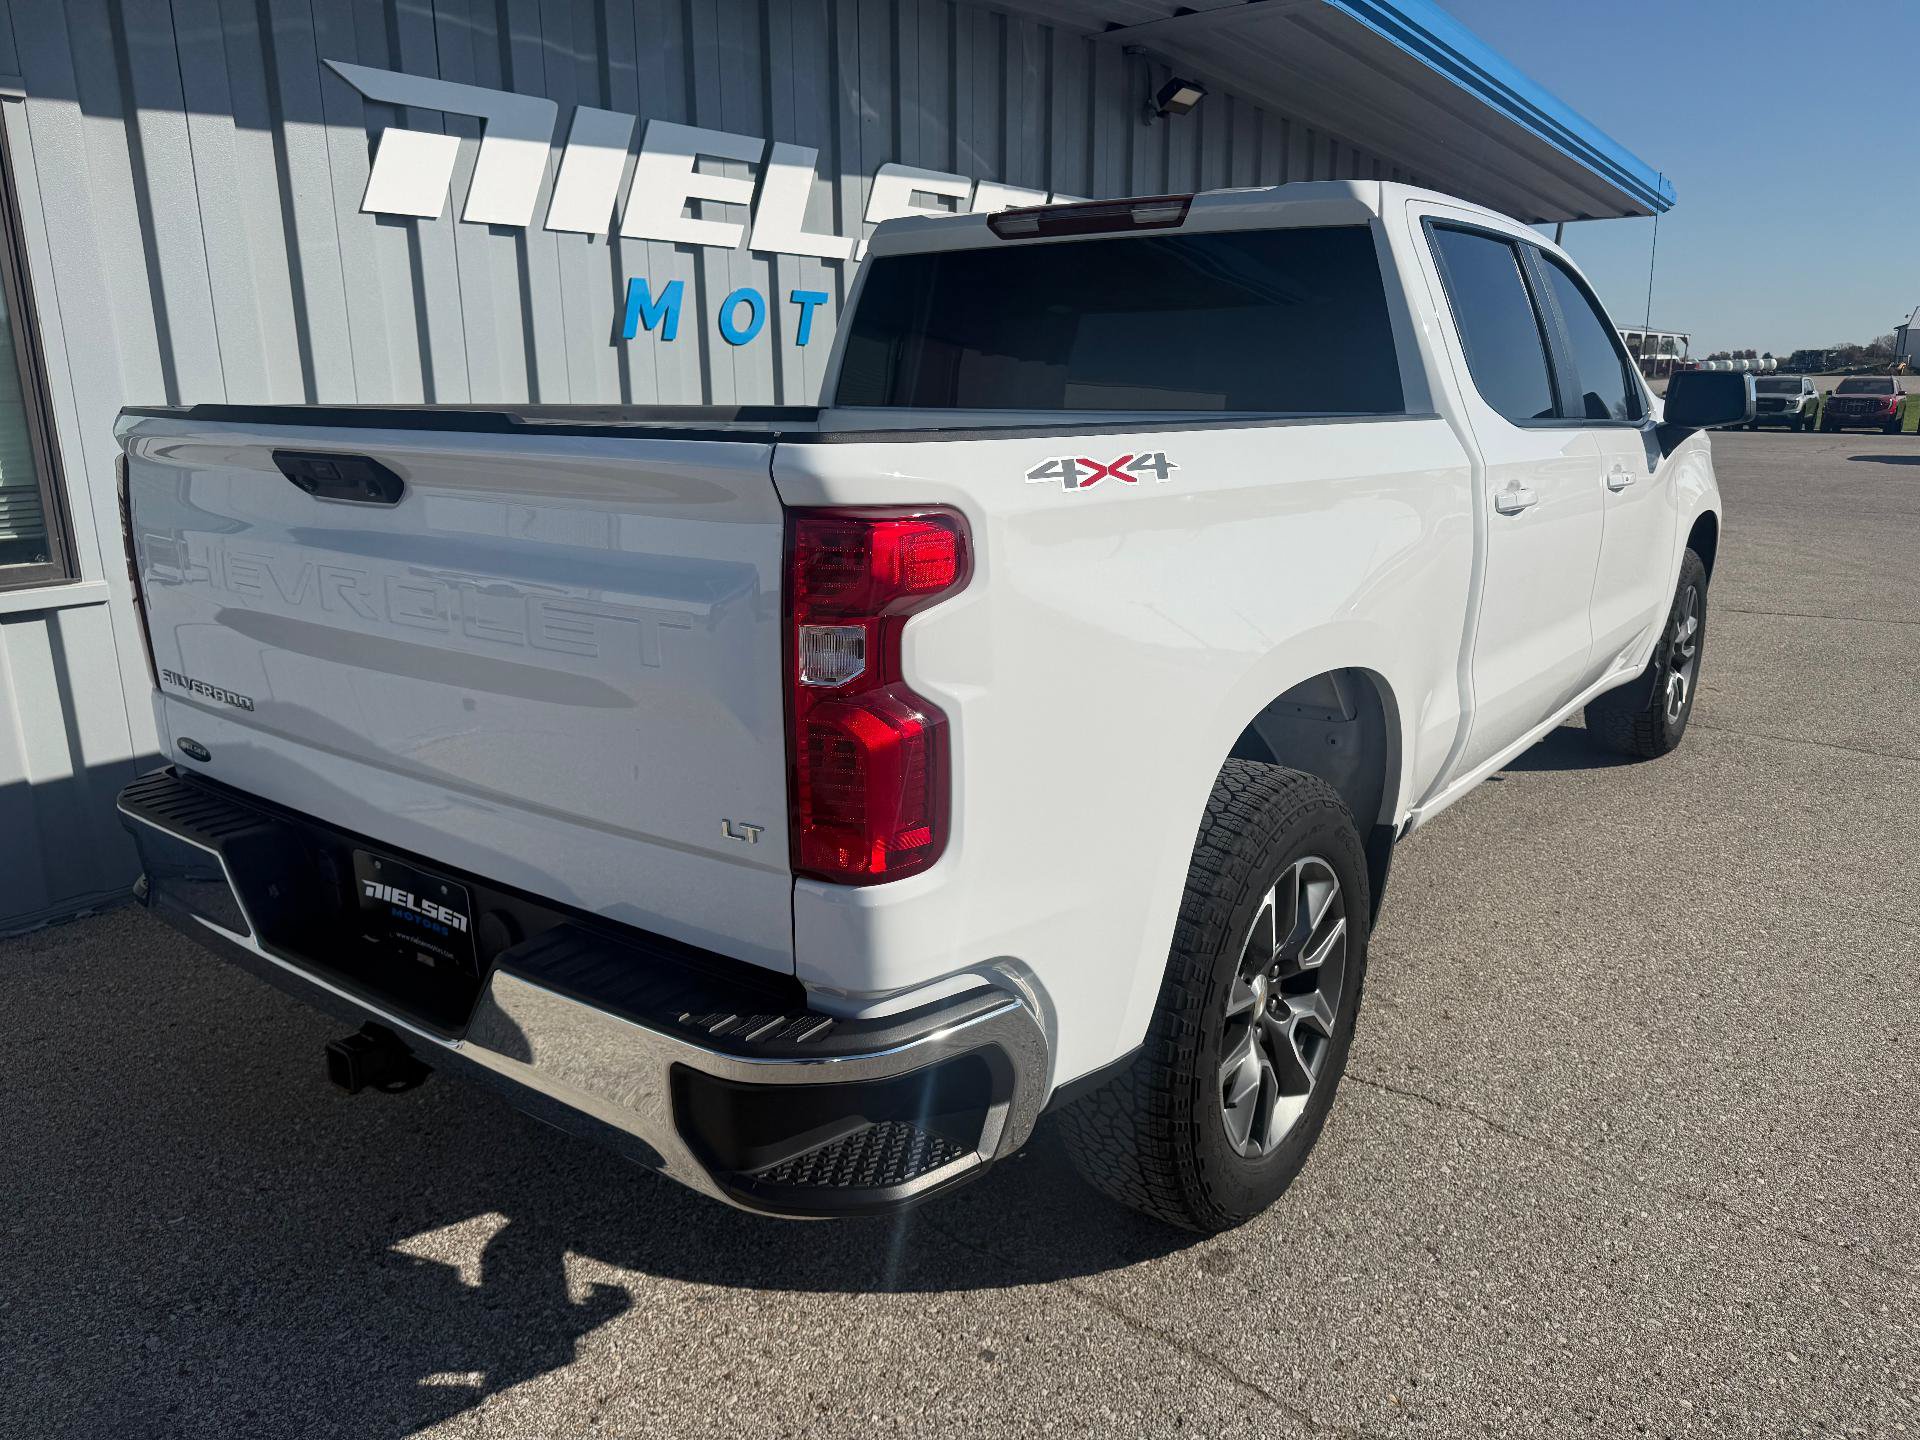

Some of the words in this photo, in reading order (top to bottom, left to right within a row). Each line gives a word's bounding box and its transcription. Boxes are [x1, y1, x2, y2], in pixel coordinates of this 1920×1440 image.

[143, 533, 694, 668] CHEVROLET
[161, 668, 255, 712] SILVERADO
[722, 818, 765, 844] LT
[362, 879, 468, 933] NIELSEN
[391, 907, 449, 936] MOTORS
